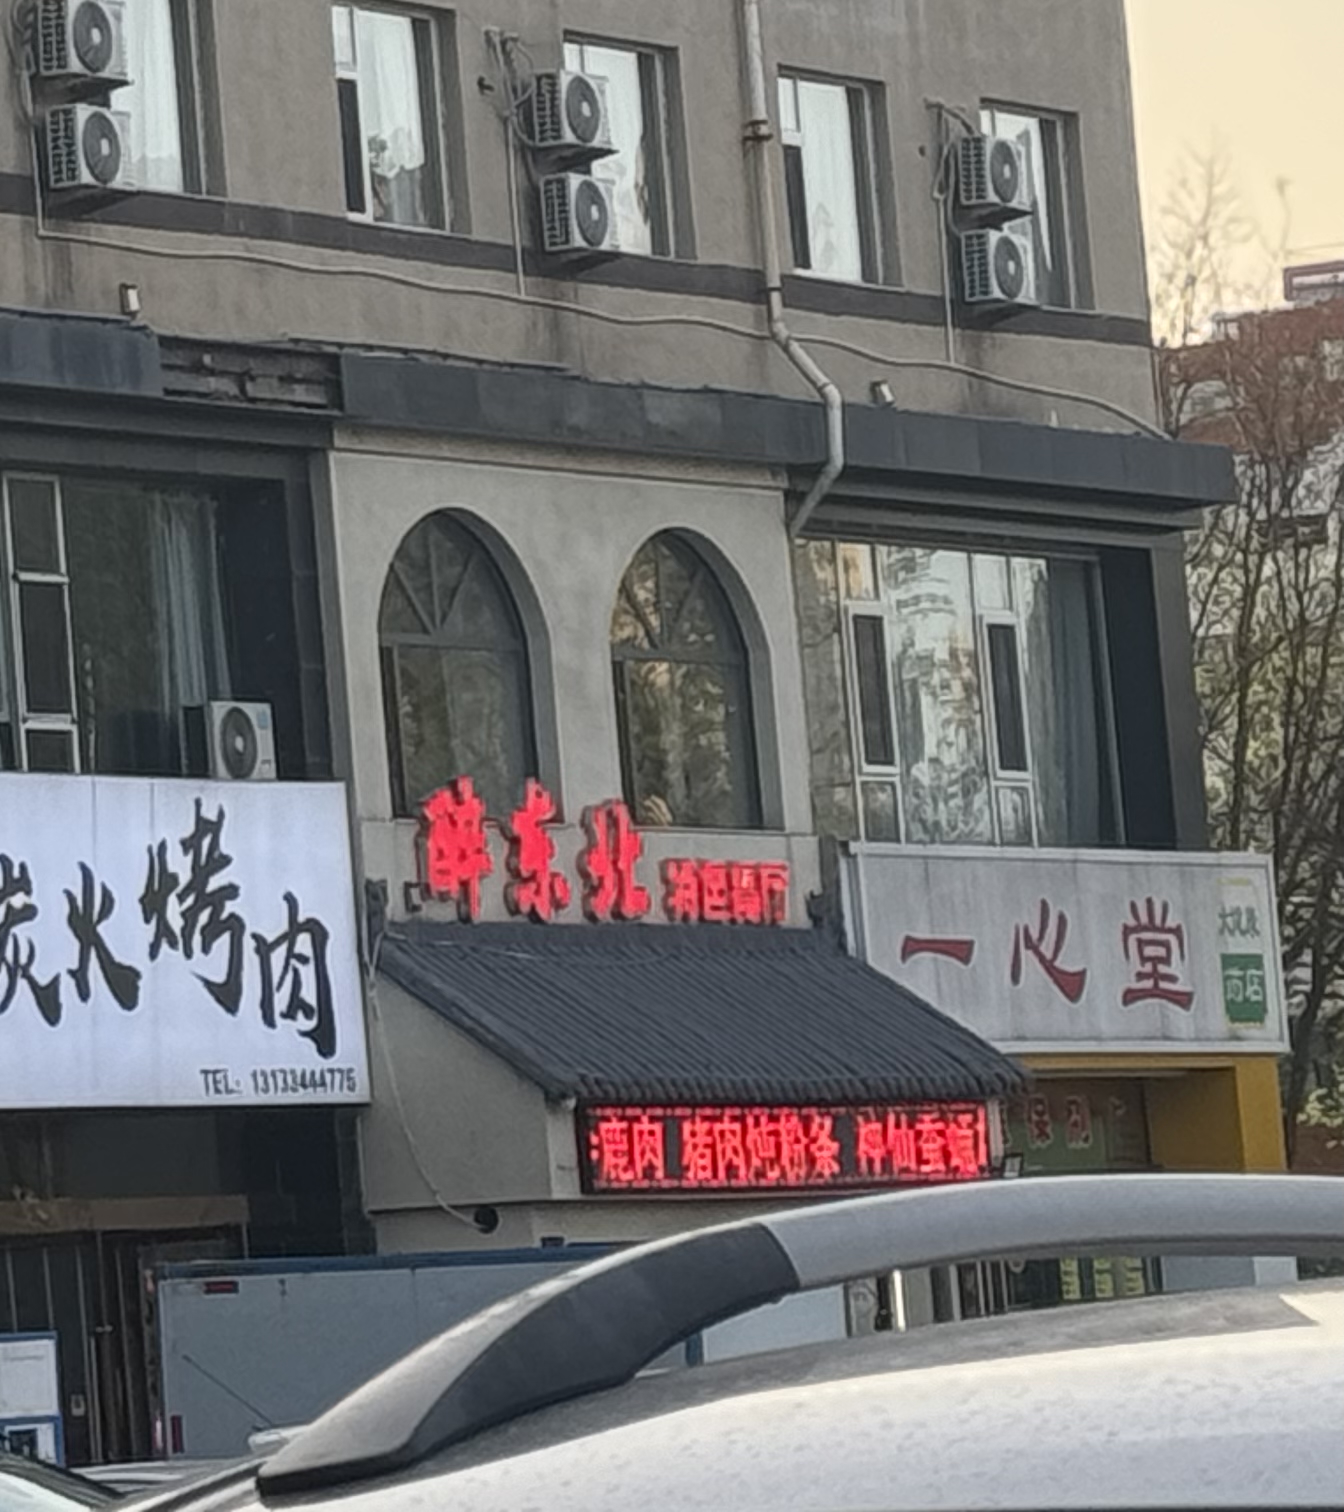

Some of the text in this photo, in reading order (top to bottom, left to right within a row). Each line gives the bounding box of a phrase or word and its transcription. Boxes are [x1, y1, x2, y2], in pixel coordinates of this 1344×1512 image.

[424, 775, 650, 920] 醉东北
[902, 897, 1194, 1011] 一心堂
